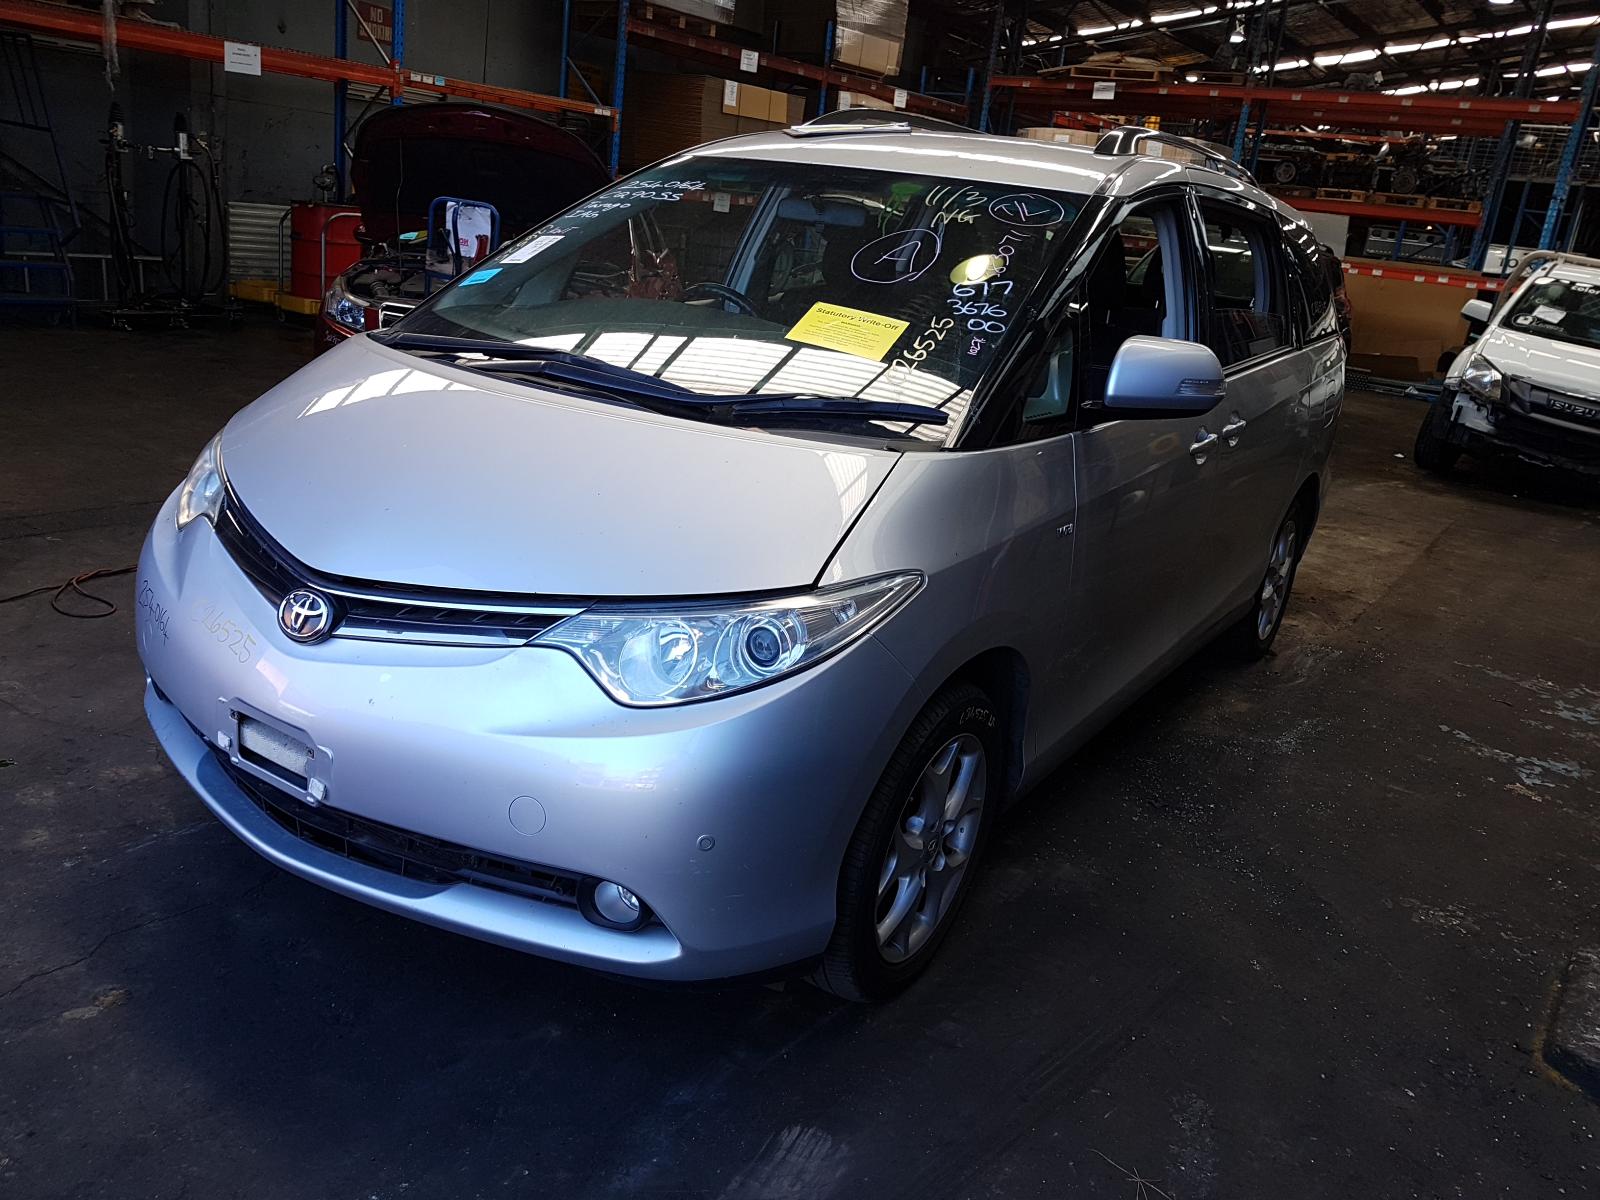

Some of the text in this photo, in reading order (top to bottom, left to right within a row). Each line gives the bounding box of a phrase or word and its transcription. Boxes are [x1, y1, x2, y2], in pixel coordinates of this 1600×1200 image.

[873, 240, 921, 272] A
[815, 307, 856, 321] Statutory
[946, 299, 1008, 317] 3676
[885, 315, 955, 385] 26525
[1550, 399, 1596, 418] ISUZU
